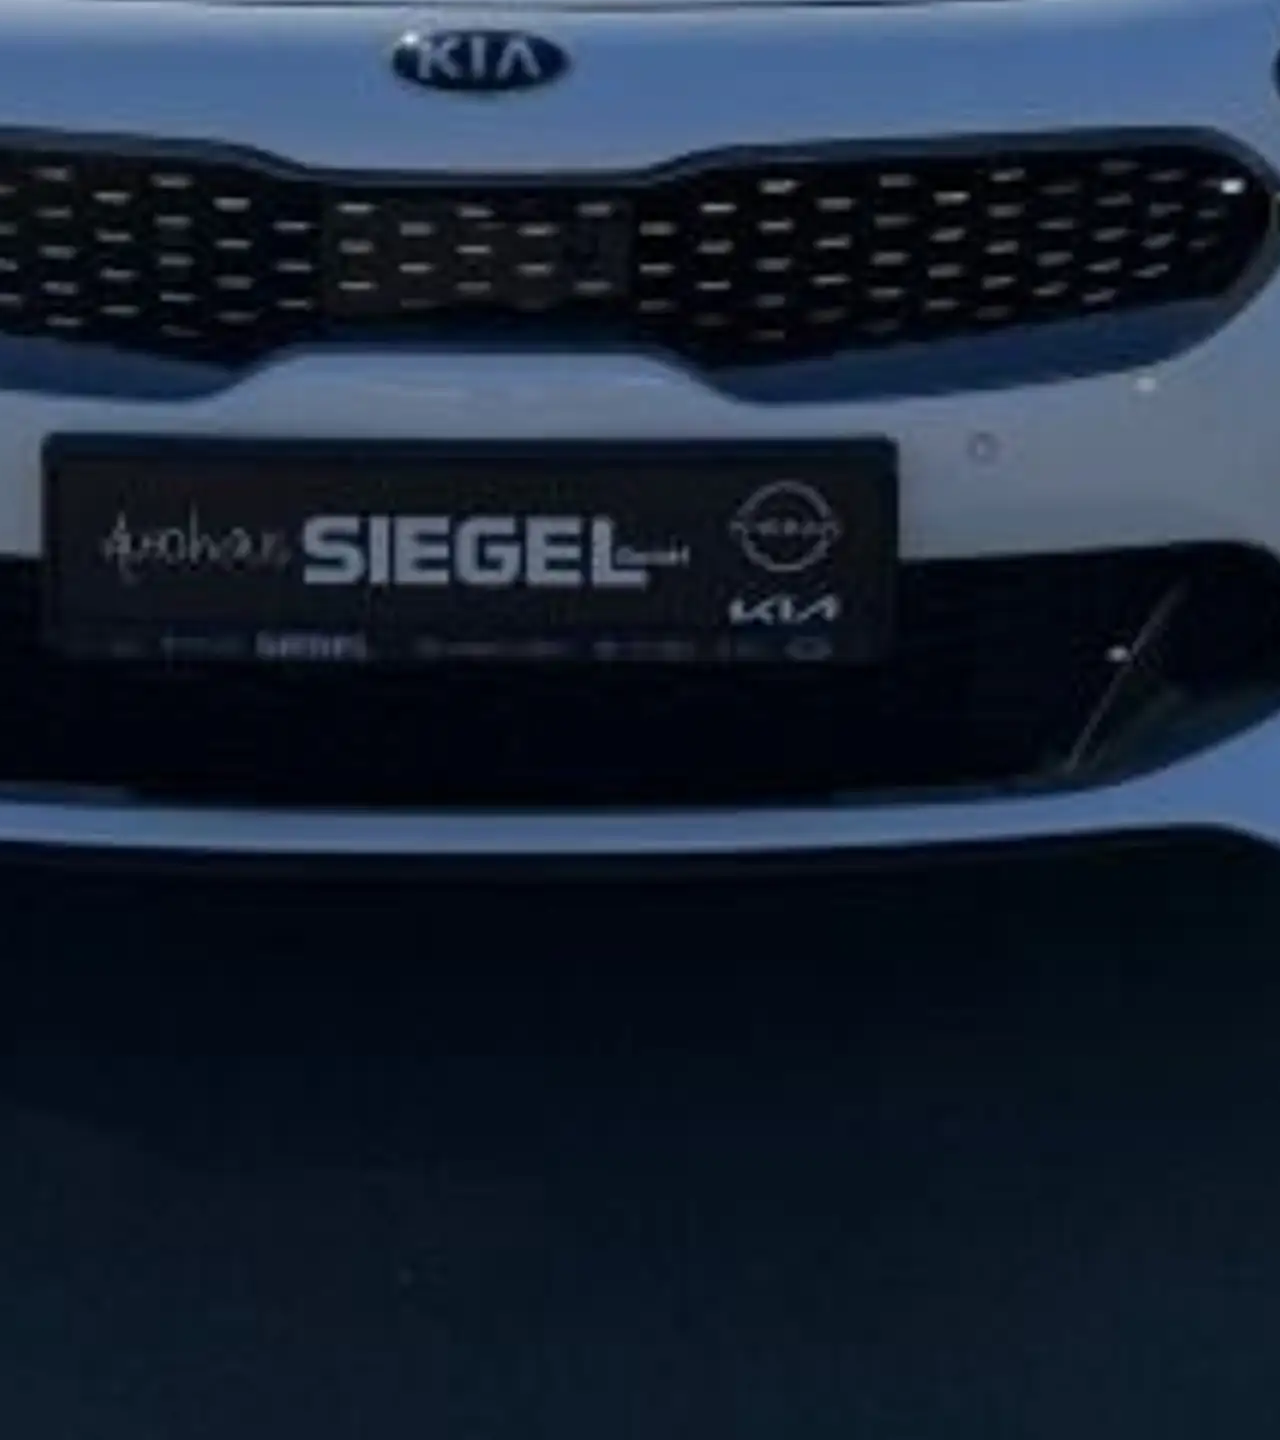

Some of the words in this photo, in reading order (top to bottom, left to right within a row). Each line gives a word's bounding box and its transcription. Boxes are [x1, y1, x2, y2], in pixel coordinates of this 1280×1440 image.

[416, 34, 543, 81] KIA
[303, 515, 648, 588] SIEGEL
[728, 594, 841, 626] KIA
